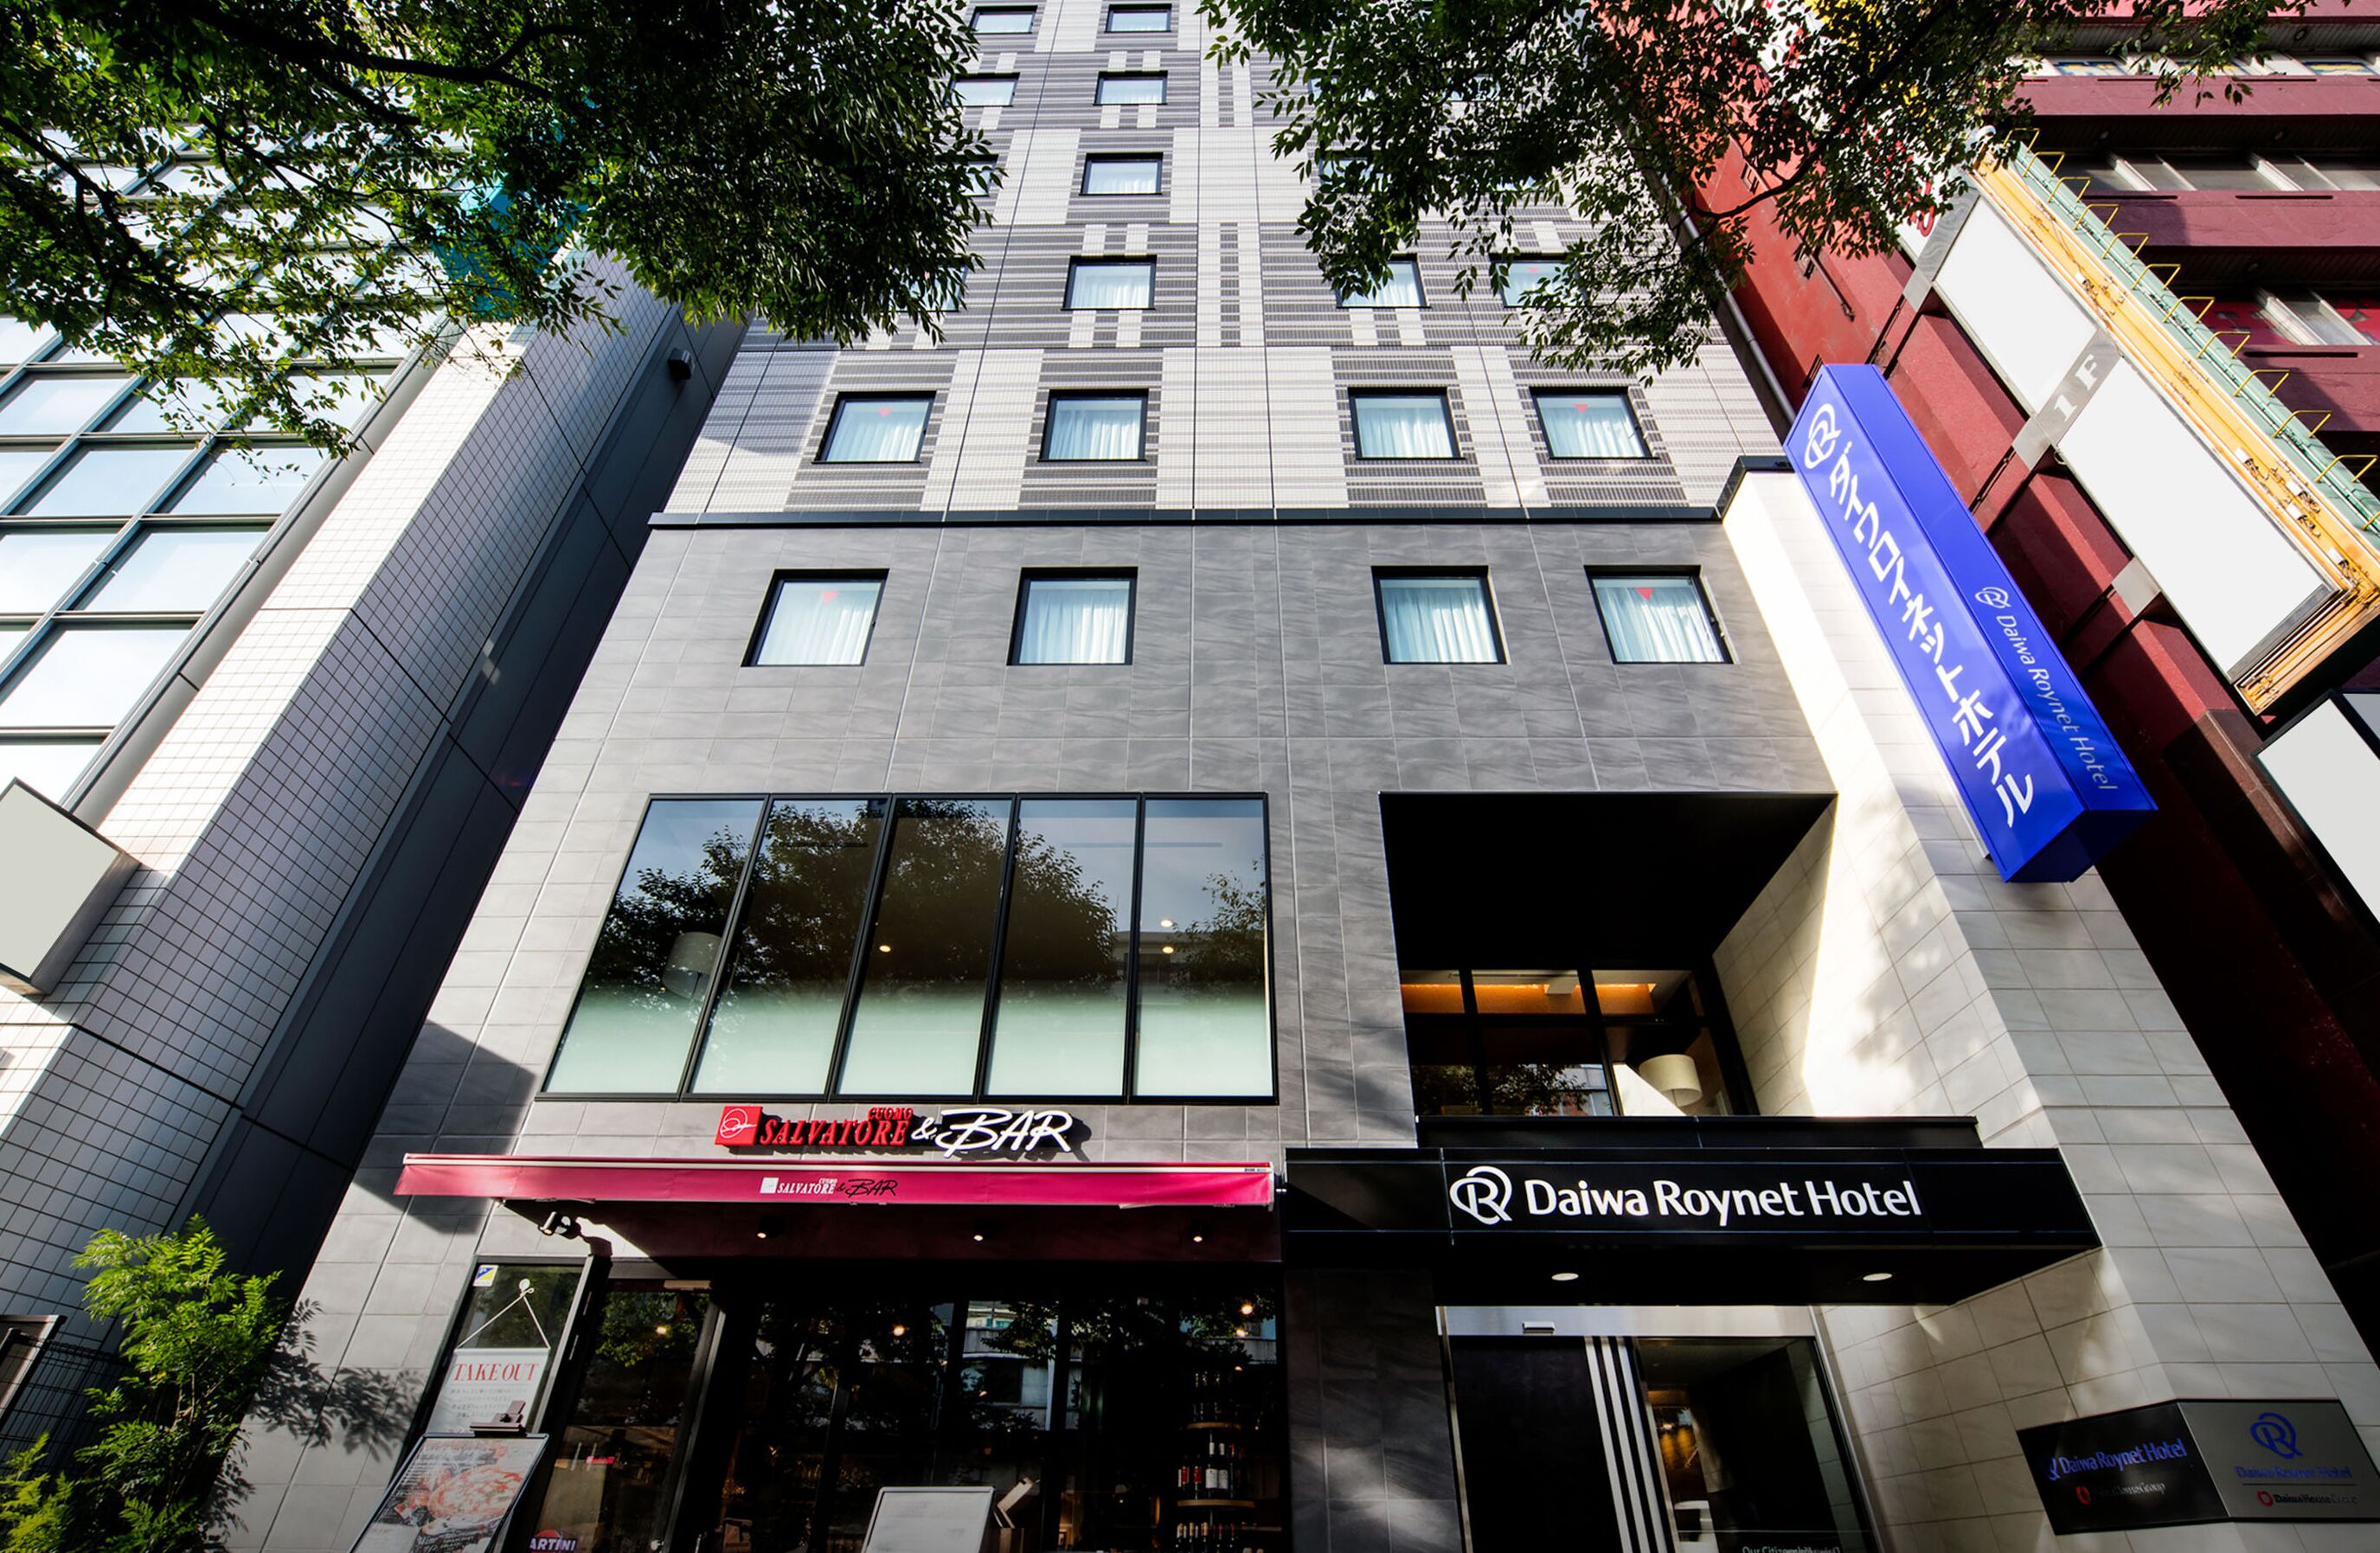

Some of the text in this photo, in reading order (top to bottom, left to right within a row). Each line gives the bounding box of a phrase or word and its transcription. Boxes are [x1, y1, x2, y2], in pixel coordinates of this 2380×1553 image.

[1830, 440, 2035, 828] ダイワロイネットホテル
[1996, 614, 2119, 791] Daiwa Roynet Hotel
[760, 1107, 1074, 1158] SALVATORE & BAR
[867, 1107, 914, 1121] CUOMO
[777, 1182, 837, 1195] SALVATORE
[844, 1178, 899, 1199] BAR
[1524, 1179, 1922, 1227] Daiwa Roynet Hotel
[2059, 1438, 2188, 1474] Daiwa Roynet Hotel
[529, 1537, 577, 1551] ARTINI
